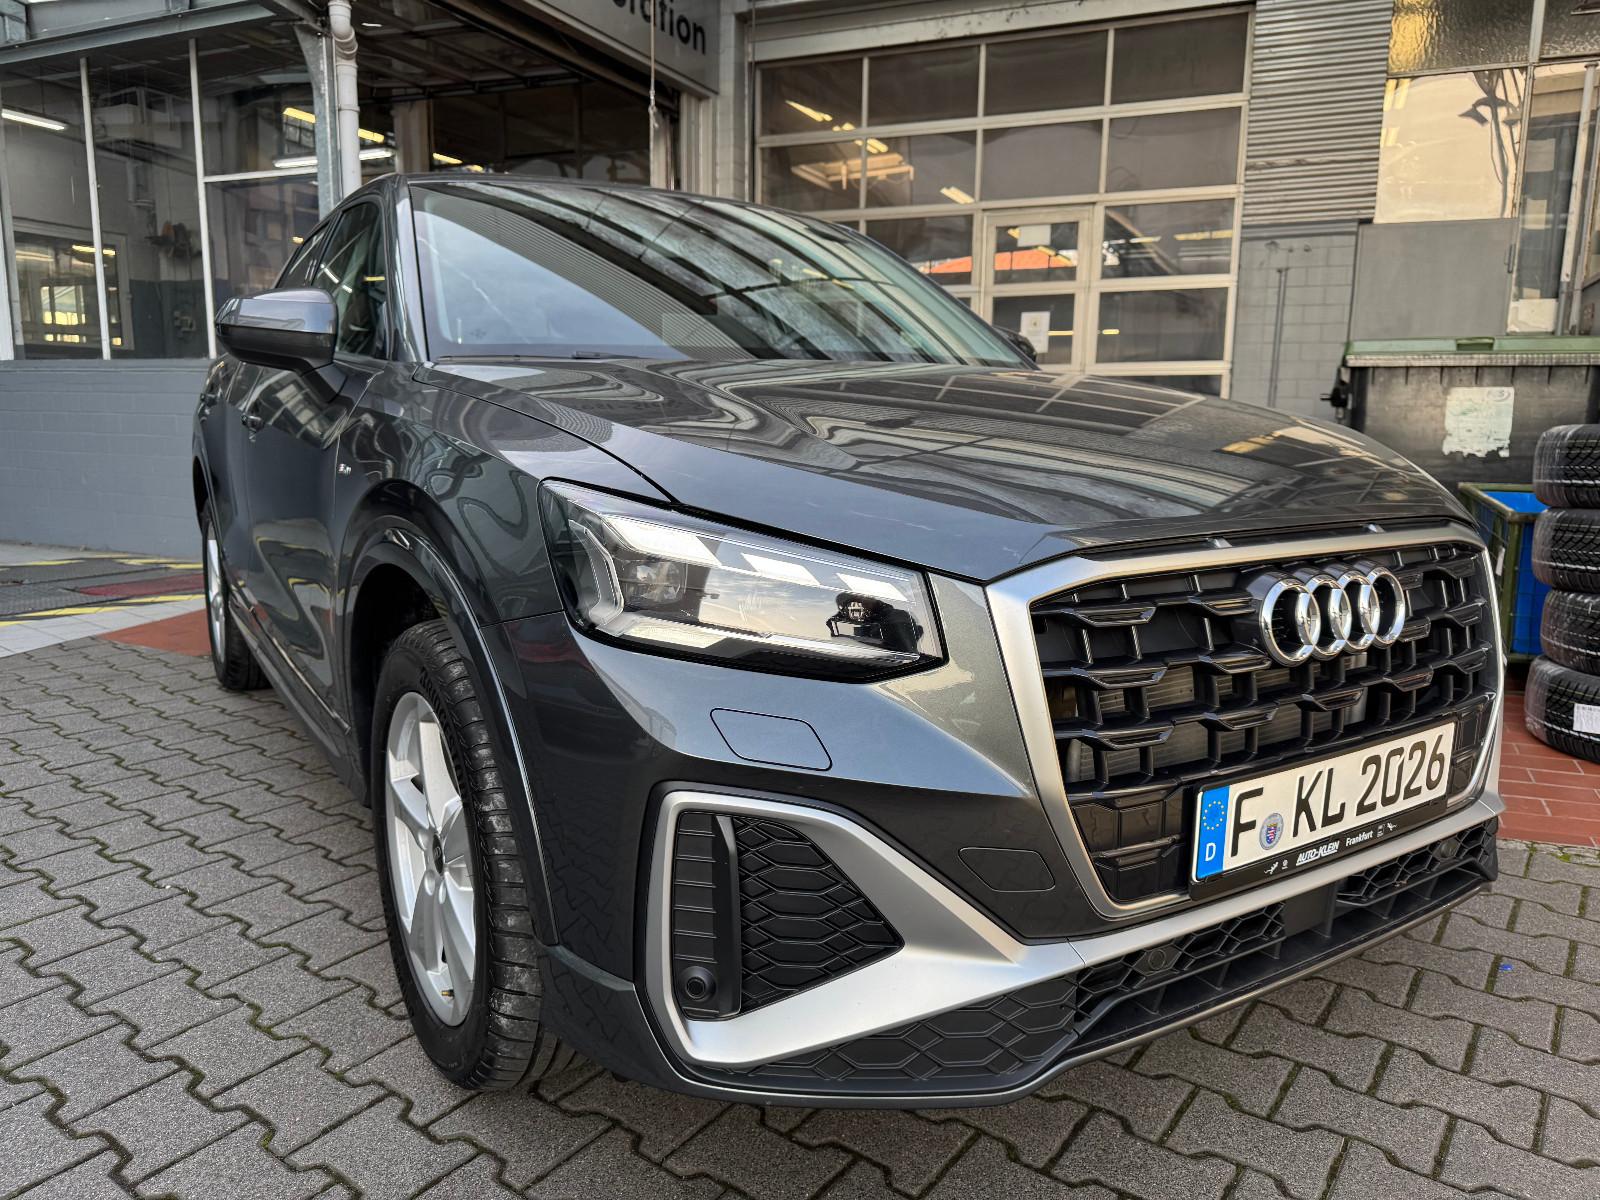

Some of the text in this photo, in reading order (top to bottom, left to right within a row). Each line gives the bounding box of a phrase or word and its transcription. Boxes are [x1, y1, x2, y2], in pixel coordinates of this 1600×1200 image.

[1231, 735, 1445, 858] F KL 2026
[1345, 830, 1374, 847] Frankfurt
[1205, 842, 1217, 862] D
